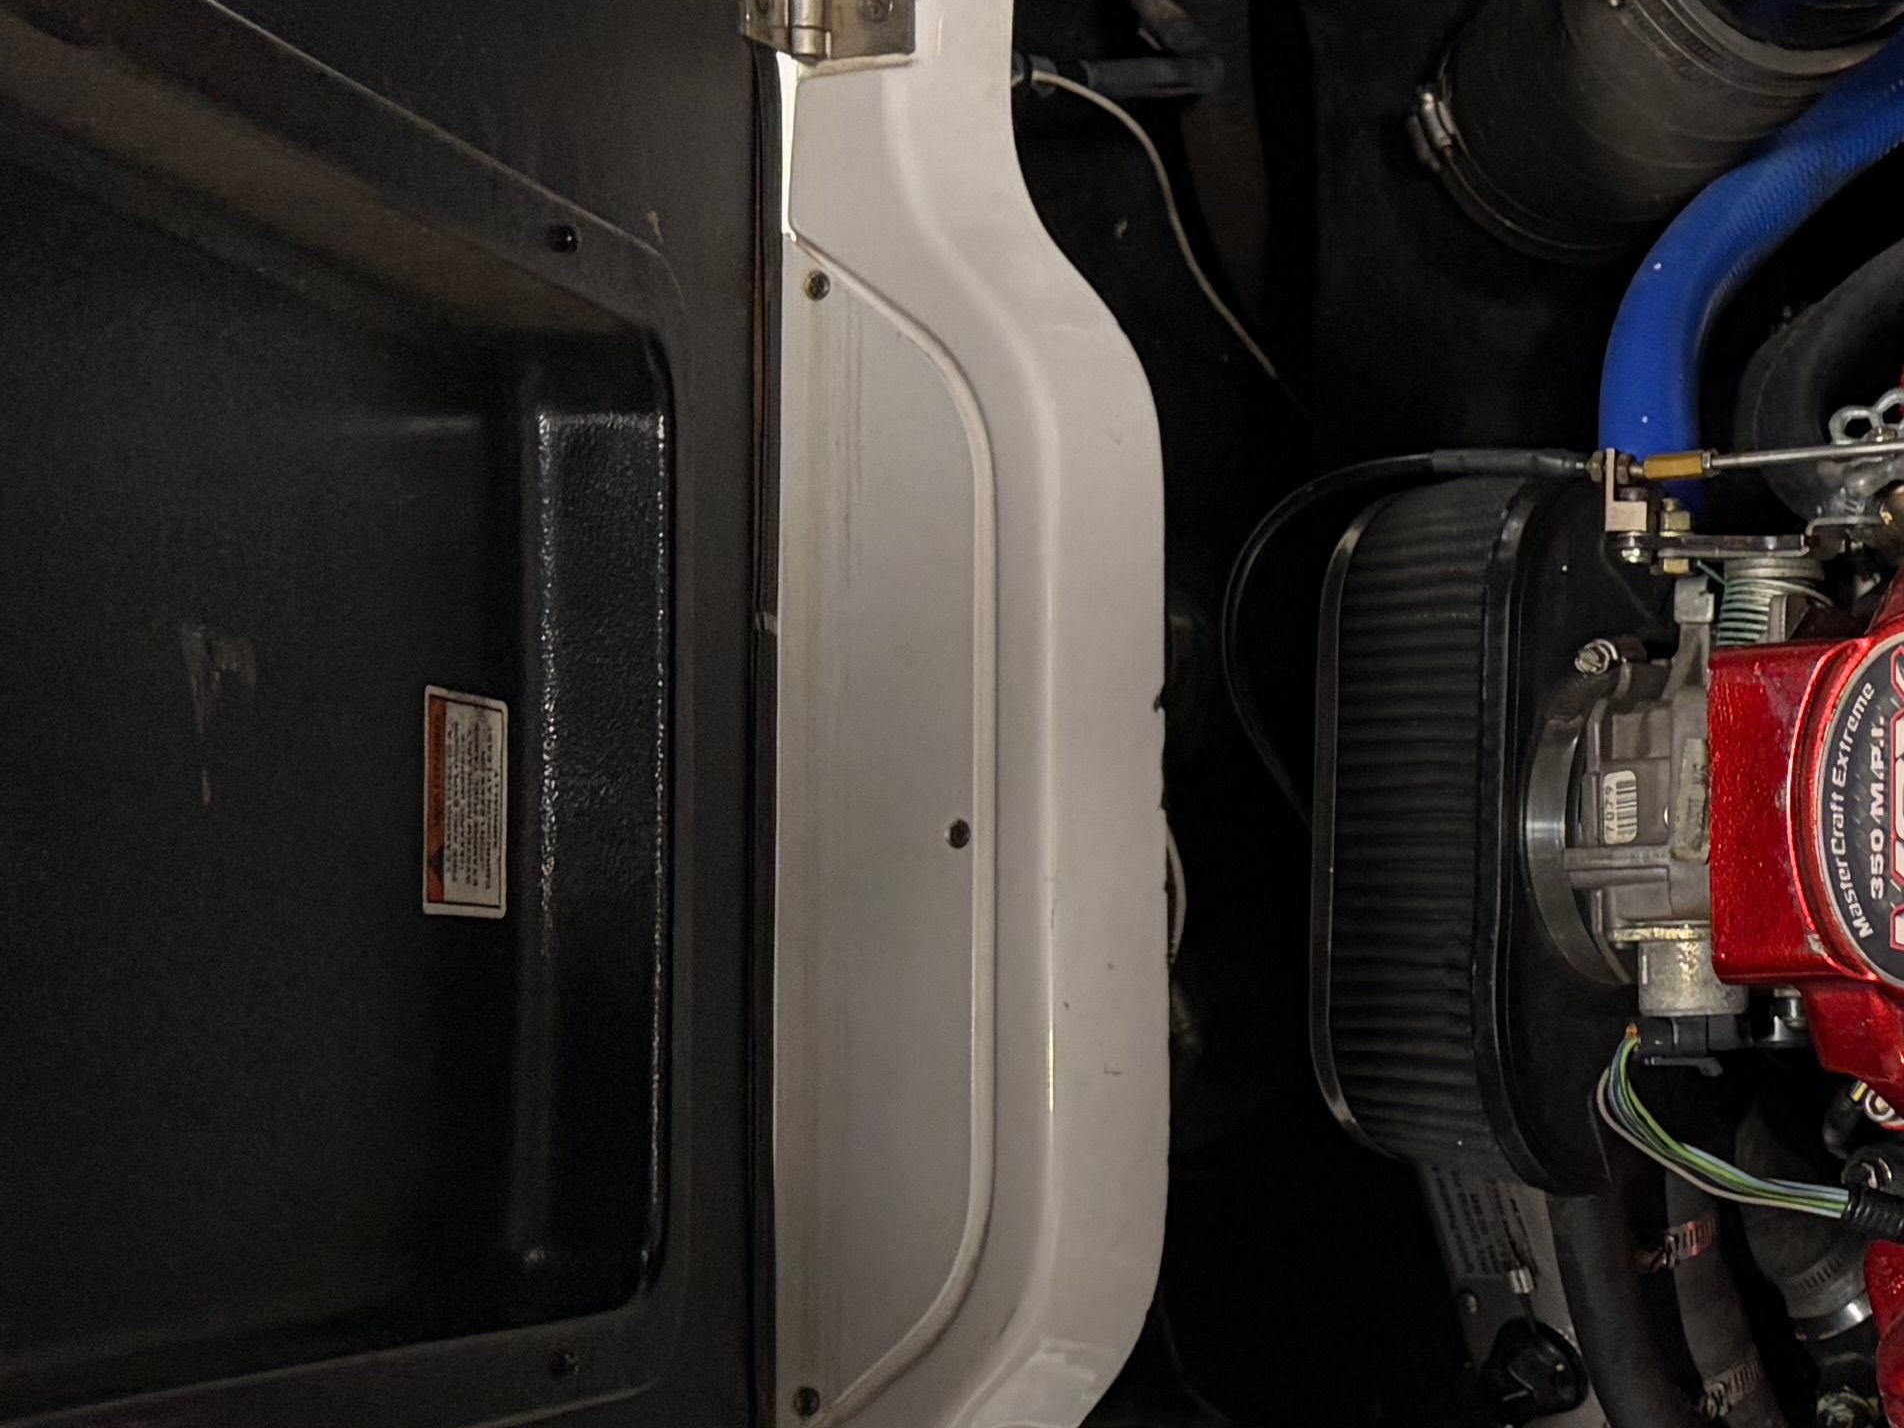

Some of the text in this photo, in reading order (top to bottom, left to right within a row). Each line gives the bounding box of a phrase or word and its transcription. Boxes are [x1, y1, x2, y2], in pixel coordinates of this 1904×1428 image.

[1831, 681, 1875, 939] MasterCraft Extreme
[1870, 716, 1886, 900] 350 M.P.I.
